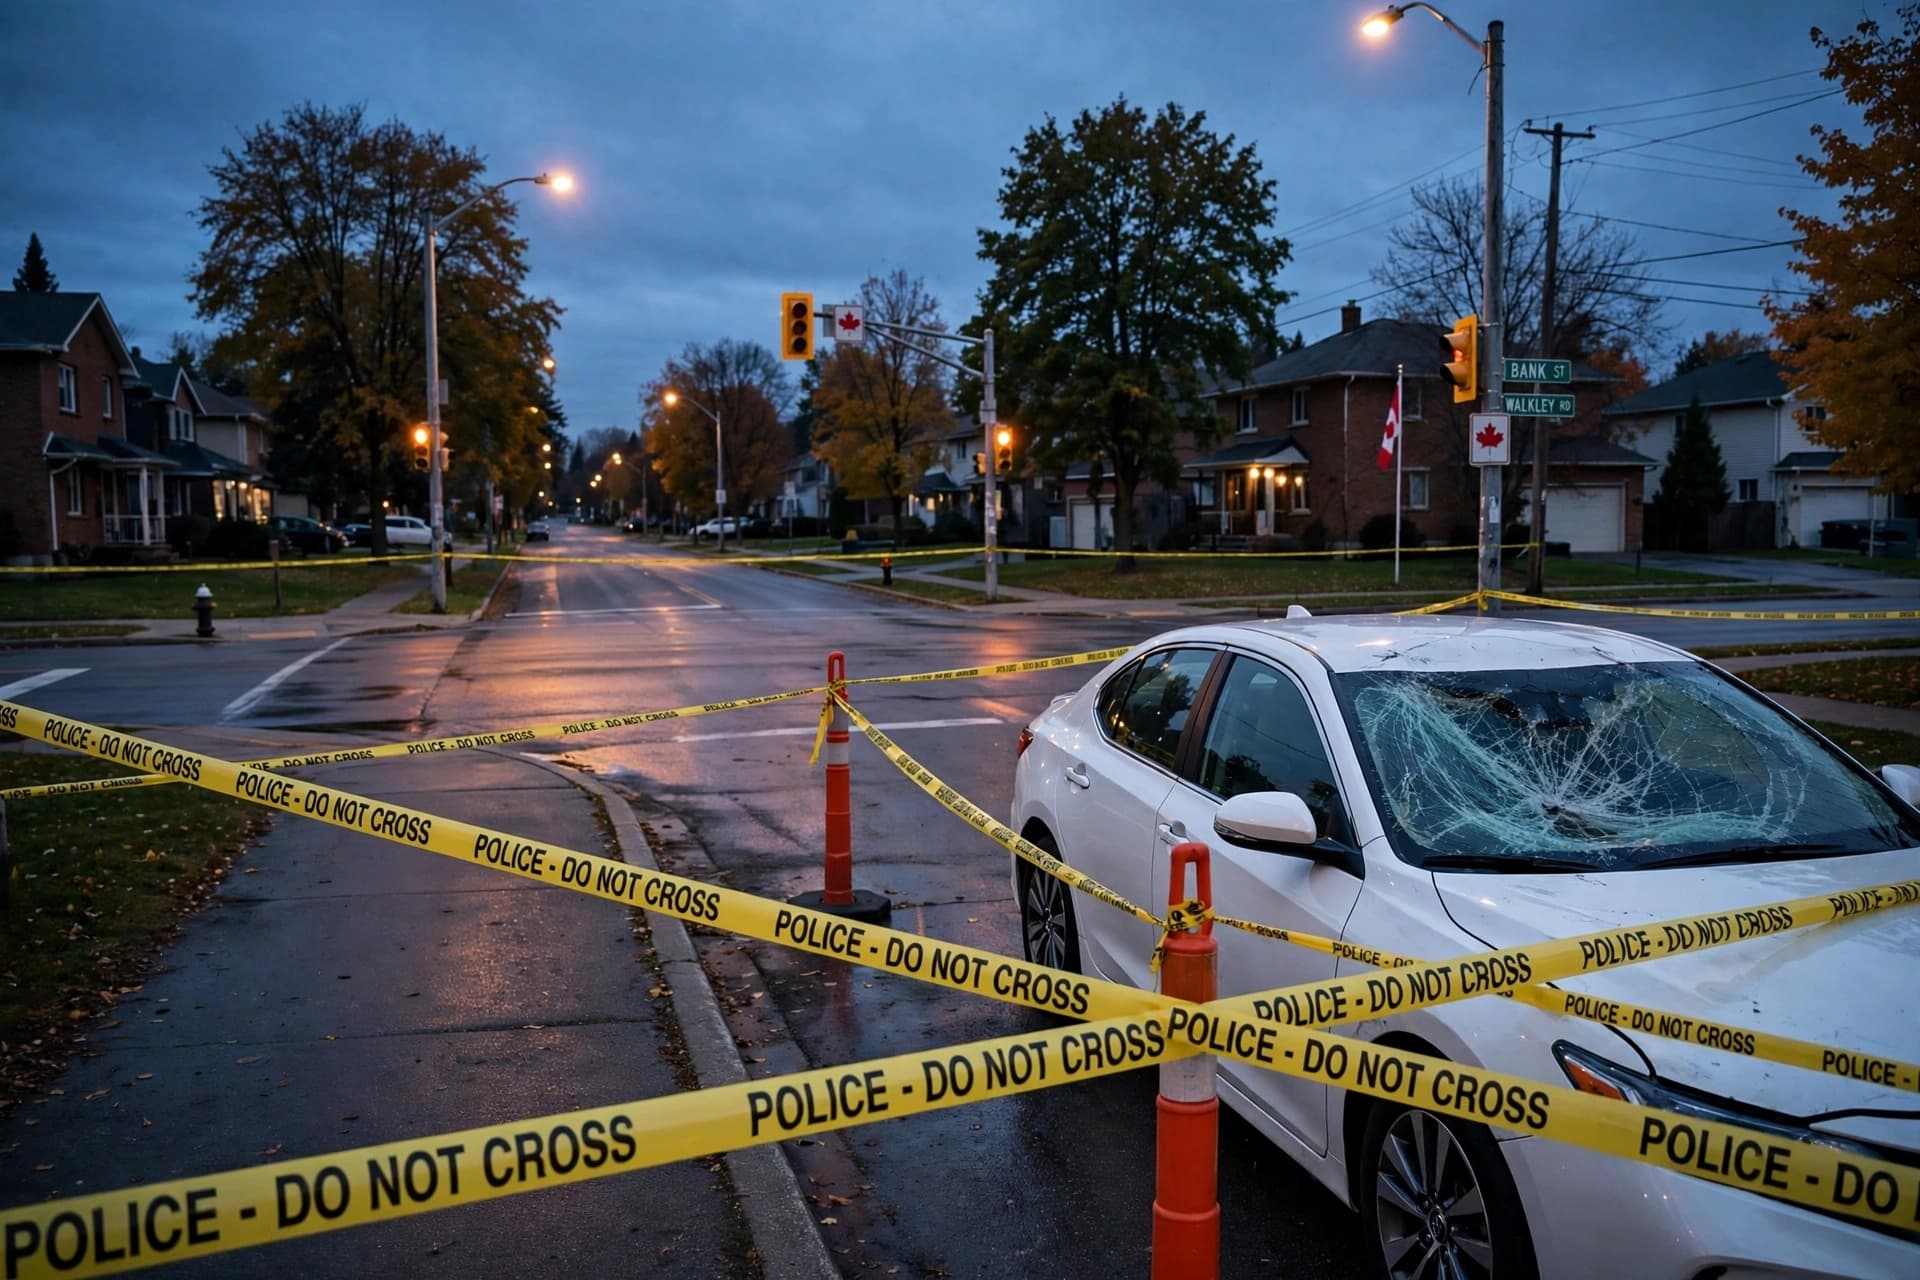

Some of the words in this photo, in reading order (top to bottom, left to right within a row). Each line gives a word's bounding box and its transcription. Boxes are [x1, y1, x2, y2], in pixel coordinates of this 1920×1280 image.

[1511, 362, 1546, 379] BANK
[1553, 365, 1565, 378] ST
[1505, 397, 1554, 412] WALKLEY
[1560, 400, 1570, 412] RD
[44, 718, 91, 750] POLICE
[100, 734, 120, 758] DO
[122, 740, 152, 767] NOT
[152, 749, 202, 781] CROSS
[408, 741, 446, 754] POLICE
[456, 738, 473, 749] DO
[475, 735, 497, 746] NOT
[500, 730, 536, 742] CROSS
[562, 722, 598, 734] POLICE
[606, 718, 622, 728] DO
[624, 715, 644, 726] NOT
[70, 782, 96, 793] NOT
[305, 755, 330, 766] NOT
[236, 772, 294, 807] POLICE
[304, 790, 330, 817] DO
[333, 796, 370, 828] NOT
[370, 808, 432, 845] CROSS
[474, 834, 546, 875] POLICE
[561, 857, 592, 888] DO
[596, 864, 642, 900] NOT
[644, 878, 720, 921] CROSS
[774, 910, 866, 958] POLICE
[886, 937, 923, 973] DO
[931, 947, 988, 989] NOT
[993, 964, 1090, 1015] CROSS
[1332, 942, 1380, 966] POLICE
[1579, 930, 1651, 970] POLICE
[1662, 922, 1694, 952] DO
[1698, 916, 1731, 948] NOT
[1738, 906, 1794, 938] CROSS
[1254, 985, 1348, 1026] POLICE
[1366, 974, 1403, 1012] DO
[1406, 966, 1451, 1004] NOT
[1460, 953, 1532, 994] CROSS
[1564, 994, 1620, 1024] POLICE
[1632, 1010, 1655, 1032] DO
[1660, 1016, 1694, 1042] NOT
[1697, 1024, 1755, 1056] CROSS
[748, 1070, 888, 1137] POLICE
[922, 1054, 974, 1103] DO
[981, 1041, 1048, 1091] NOT
[1060, 1018, 1166, 1075] CROSS
[1167, 1008, 1278, 1064] POLICE
[1303, 1039, 1348, 1080] DO
[1357, 1050, 1424, 1098] NOT
[1432, 1070, 1550, 1130] CROSS
[1822, 1051, 1897, 1087] POLICE
[4, 1187, 220, 1280] POLICE
[275, 1166, 350, 1228] DO
[367, 1144, 465, 1211] NOT
[484, 1115, 636, 1188] CROSS
[1640, 1116, 1791, 1190] POLICE
[1833, 1162, 1899, 1216] DO
